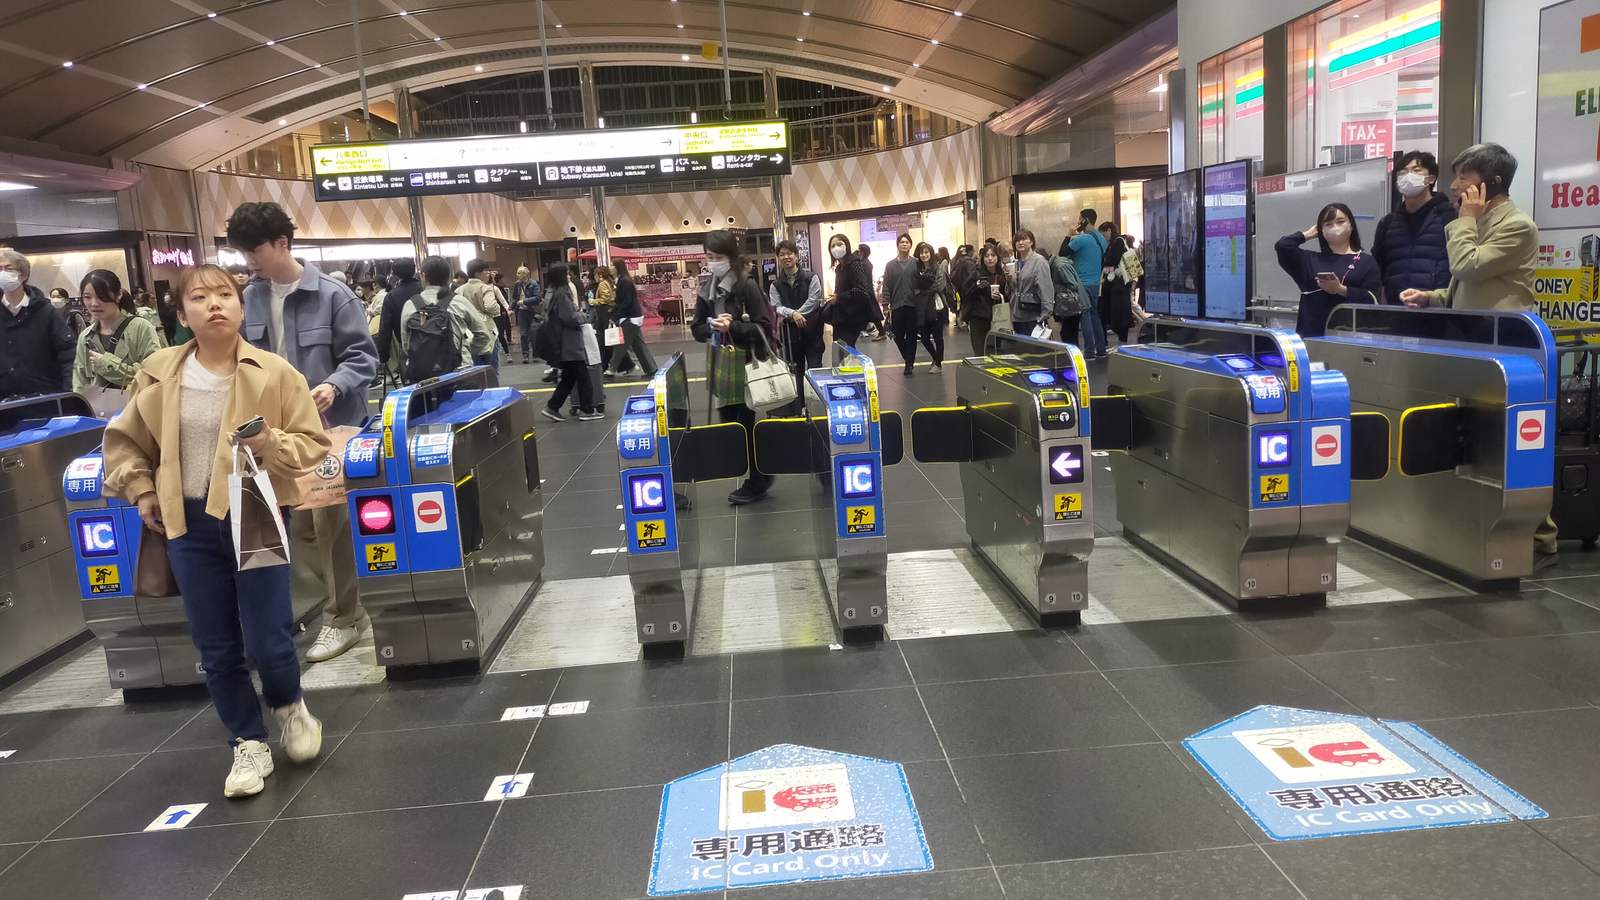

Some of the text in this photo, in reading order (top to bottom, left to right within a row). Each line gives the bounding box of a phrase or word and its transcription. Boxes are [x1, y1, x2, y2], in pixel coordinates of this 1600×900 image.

[1576, 86, 1600, 116] EL
[1347, 124, 1387, 141] TAX-
[489, 168, 518, 176] タクシー
[1535, 279, 1573, 294] ONEY
[836, 423, 862, 436] 専用
[624, 437, 651, 450] 専用
[1261, 435, 1288, 462] IC
[67, 479, 96, 493] 専用
[846, 466, 872, 491] IC
[634, 481, 663, 507] IC
[83, 523, 115, 550] IC
[1048, 595, 1054, 603] 9
[1072, 593, 1081, 601] 10
[672, 623, 678, 631] 8
[385, 648, 391, 656] 6
[1268, 777, 1473, 809] 専用通路
[1295, 799, 1495, 828] IC Card Only
[691, 824, 886, 861] 専用通路
[691, 849, 889, 882] IC Card Only
